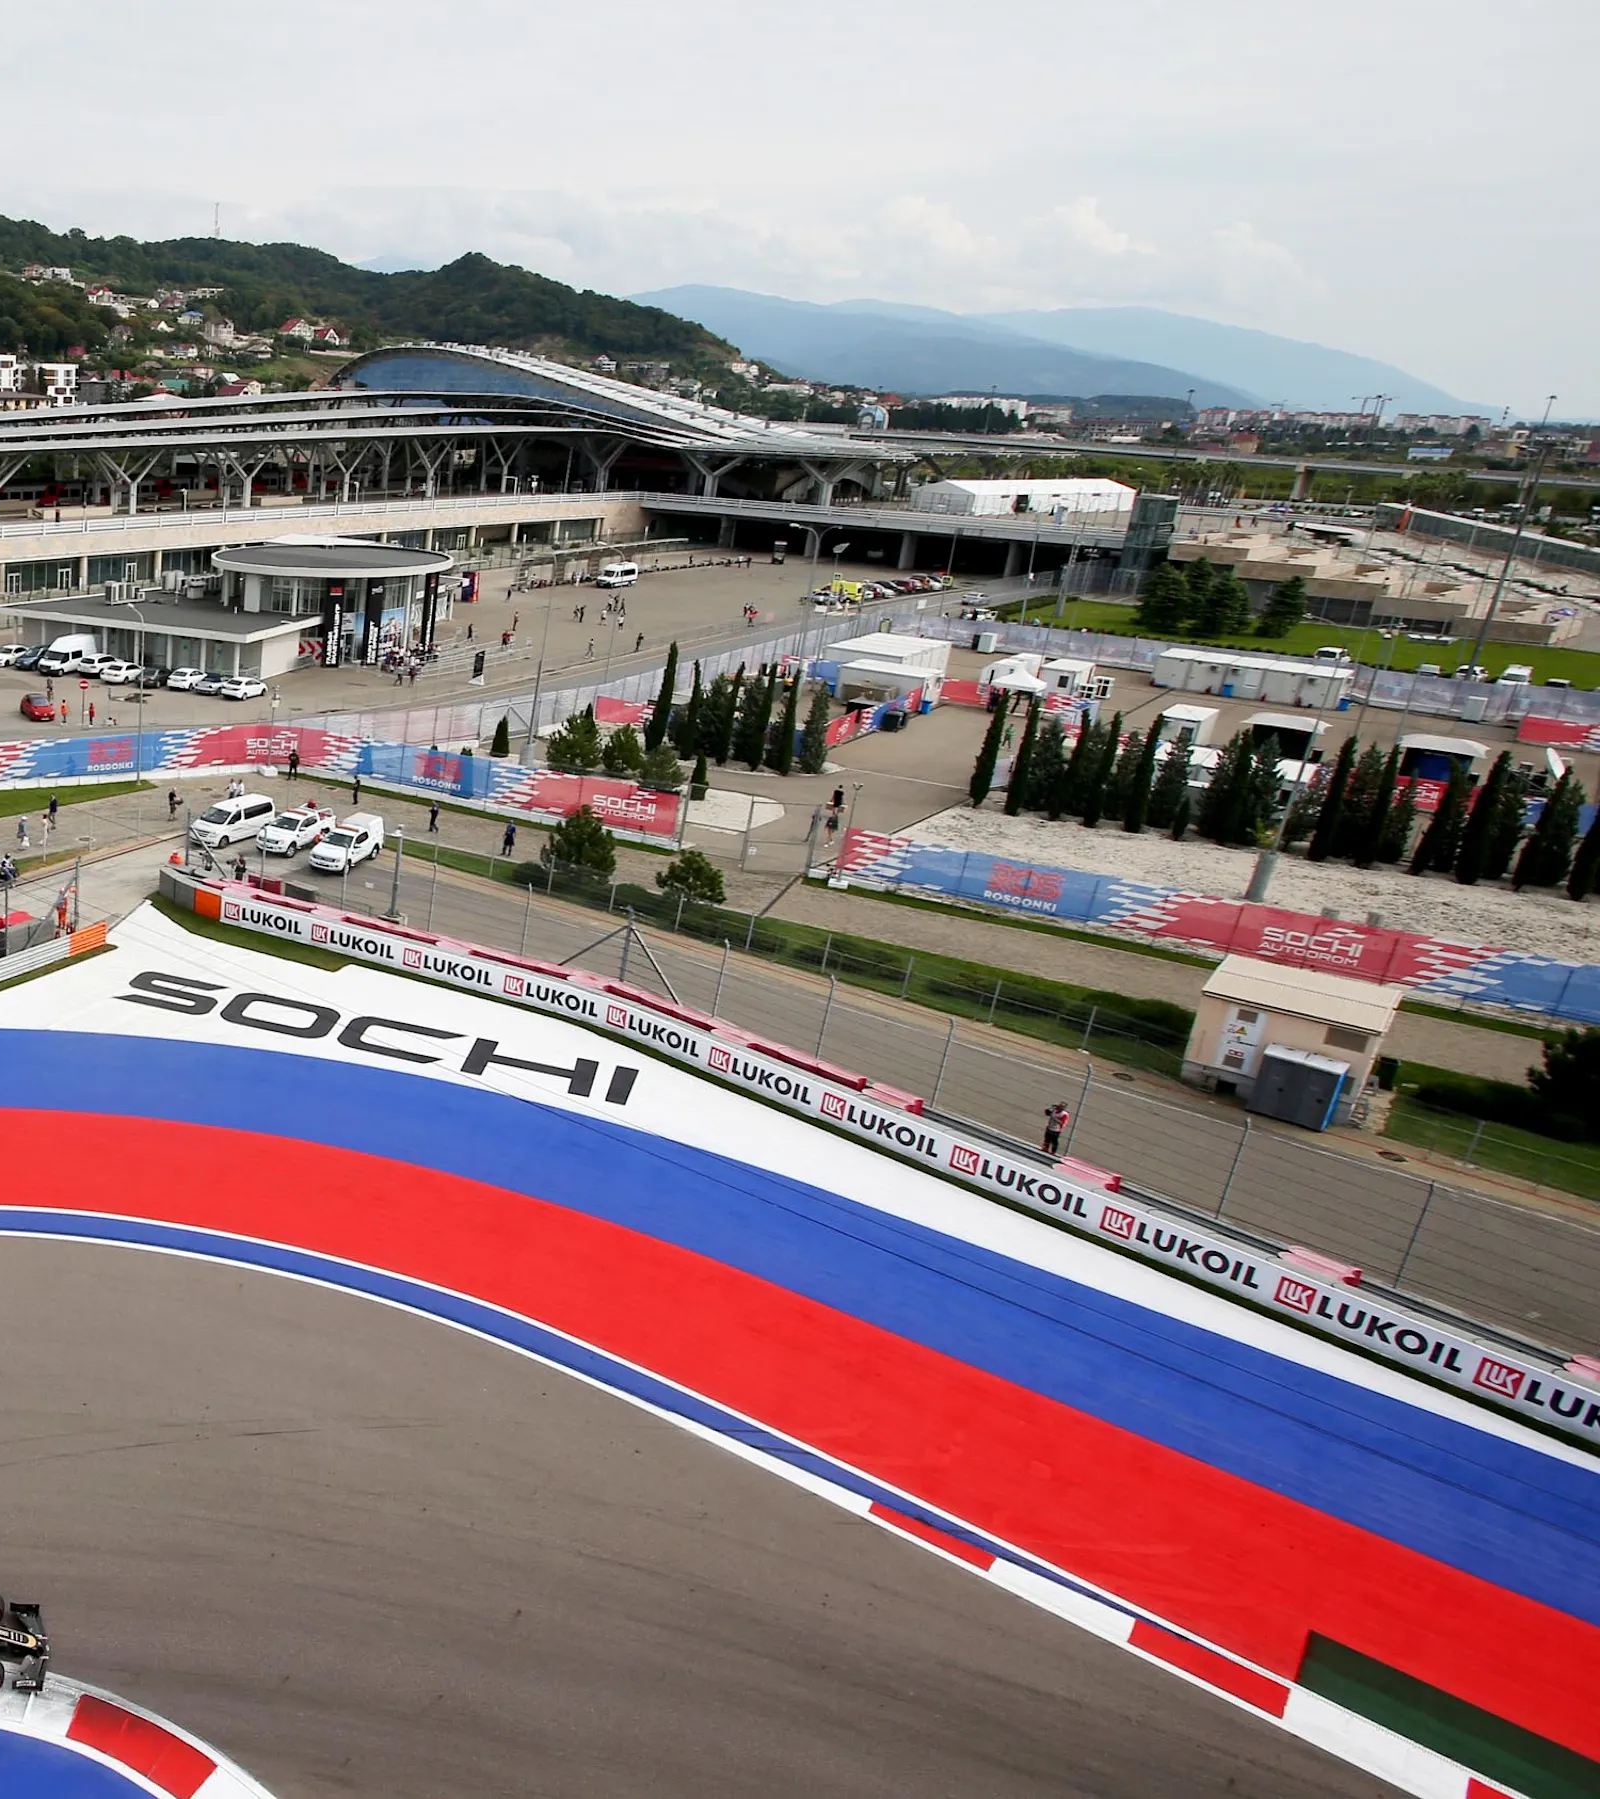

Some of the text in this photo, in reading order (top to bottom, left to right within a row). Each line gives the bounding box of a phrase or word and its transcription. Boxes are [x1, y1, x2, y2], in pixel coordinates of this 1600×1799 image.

[246, 738, 298, 750] SOCHI
[412, 775, 462, 791] ROSGONKI
[591, 806, 655, 822] AUTODROM
[593, 794, 656, 814] SOCHI
[984, 890, 1057, 912] ROSGONKI
[242, 908, 301, 934] LUKOIL
[330, 931, 393, 959] LUKOIL
[1258, 941, 1359, 966] AUTODROM
[1262, 927, 1364, 957] SOCHI
[424, 956, 492, 986] LUKOIL
[526, 983, 597, 1017] LUKOIL
[113, 970, 639, 1105] SOCHI
[629, 1015, 698, 1057] LUKOIL
[732, 1058, 810, 1104] LUKOIL
[847, 1105, 937, 1157] LUKOIL
[981, 1160, 1086, 1218] LUKOIL
[1136, 1223, 1258, 1289] LUKOIL
[1316, 1296, 1461, 1373] LUKOIL
